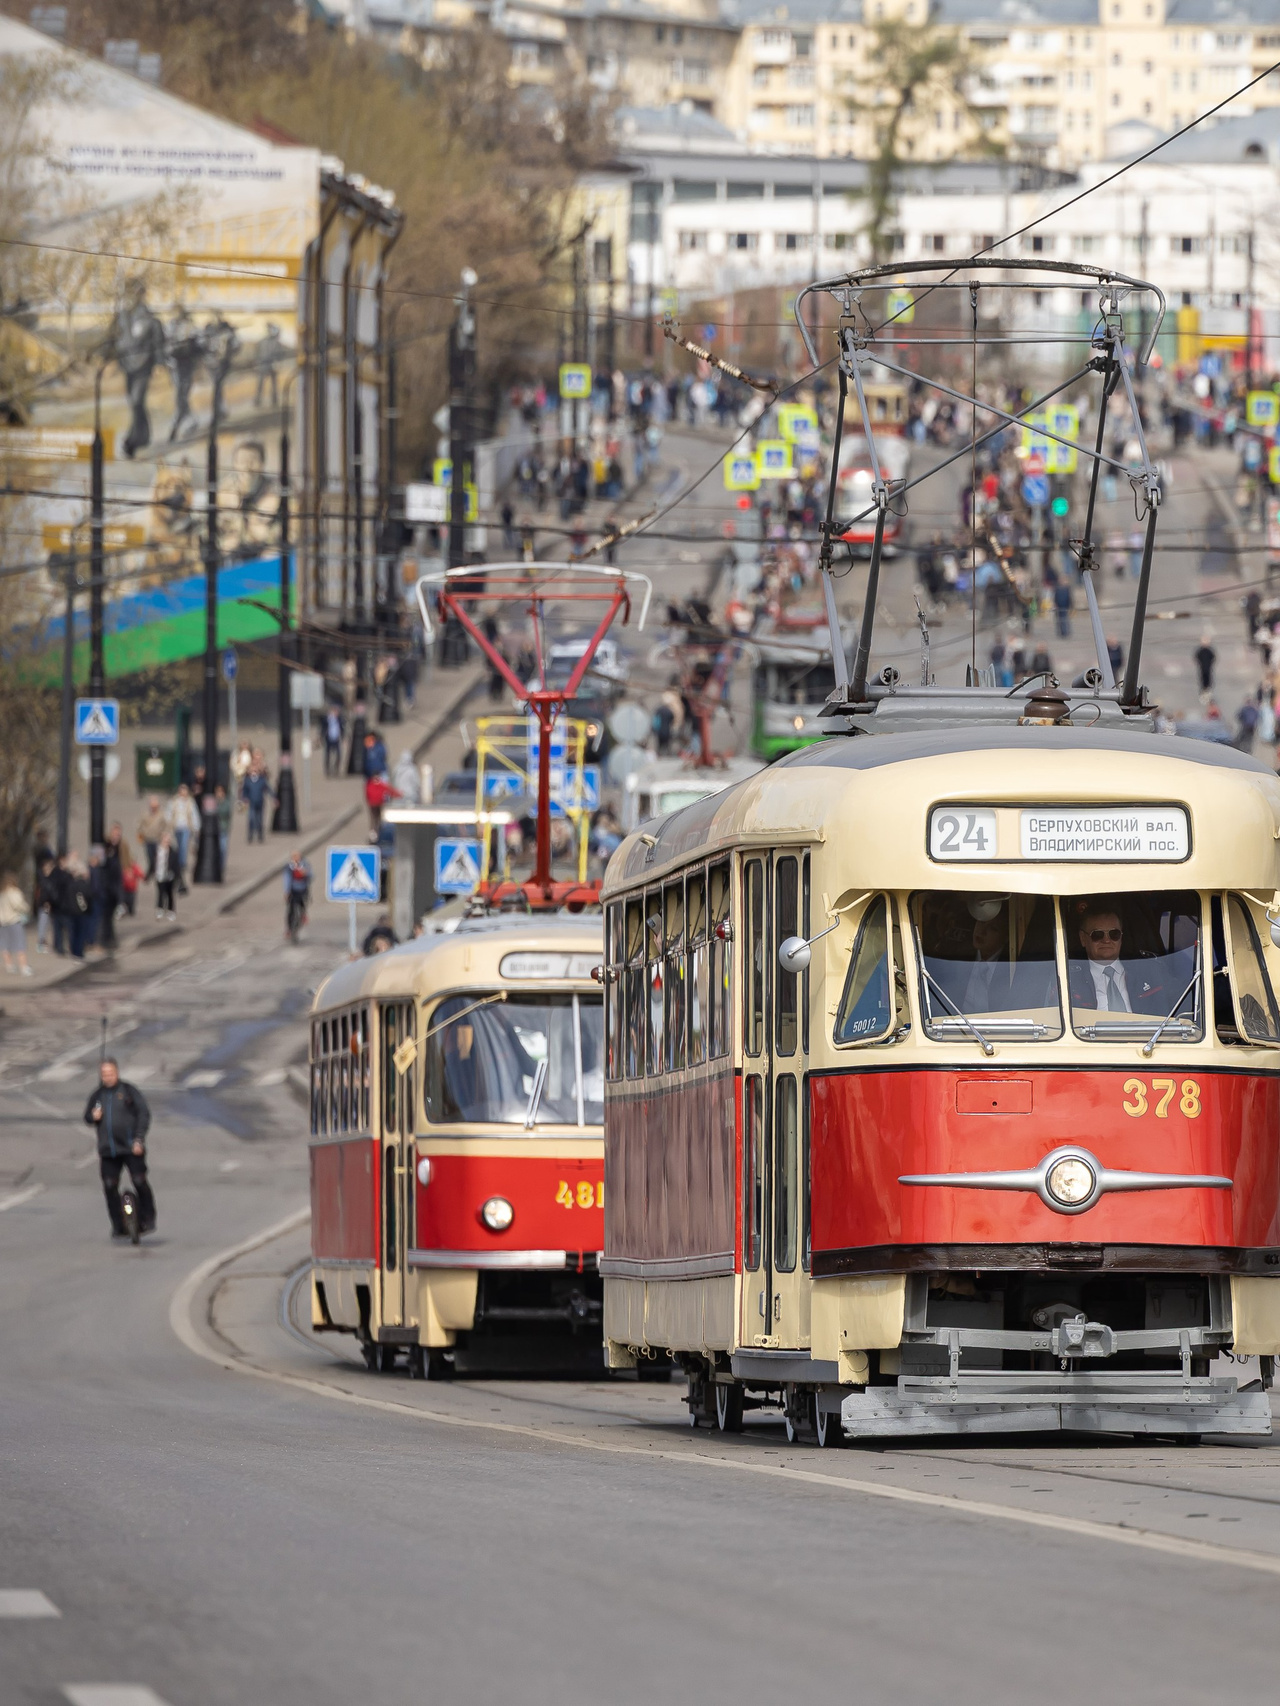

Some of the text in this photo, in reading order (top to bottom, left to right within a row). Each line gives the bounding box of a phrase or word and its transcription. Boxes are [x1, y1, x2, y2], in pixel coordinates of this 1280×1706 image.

[937, 814, 989, 852] 24
[852, 1016, 877, 1033] 50012
[1122, 1077, 1202, 1119] 378
